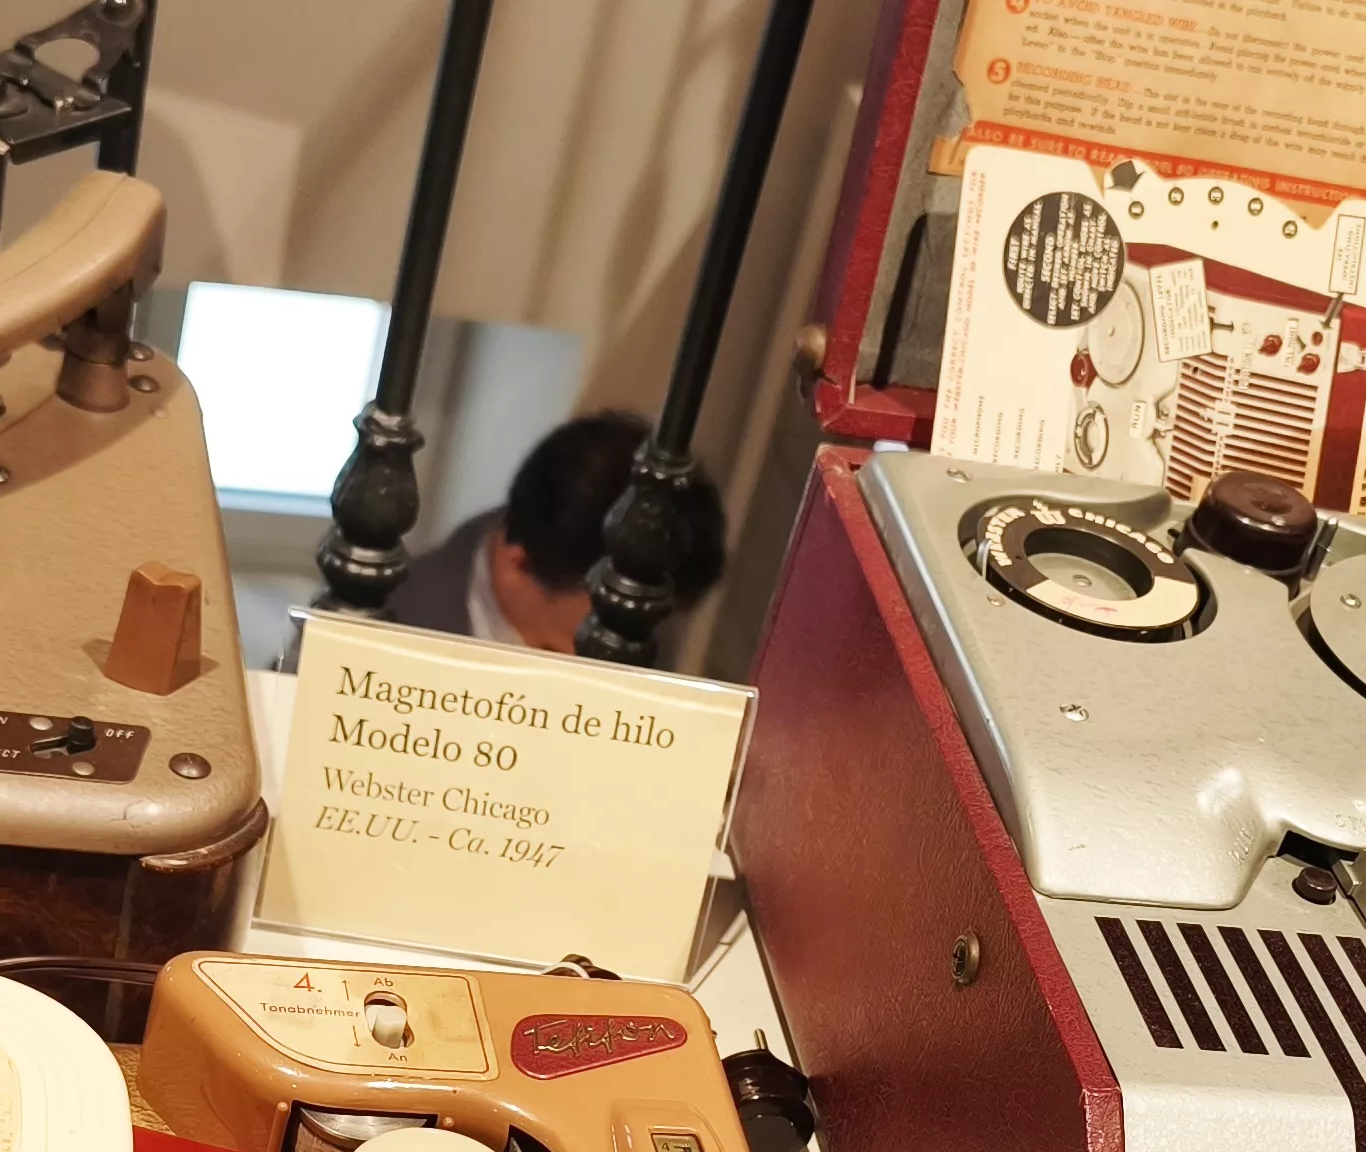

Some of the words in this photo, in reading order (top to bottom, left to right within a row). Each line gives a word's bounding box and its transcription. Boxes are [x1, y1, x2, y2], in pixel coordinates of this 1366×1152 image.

[1067, 508, 1175, 564] CHICAGO
[336, 666, 549, 731] Magnetofón
[562, 705, 601, 738] de
[611, 708, 675, 749] hilo
[105, 728, 135, 740] OFF
[329, 714, 462, 763] Modelo
[473, 742, 519, 772] 80
[323, 766, 435, 809] Webster
[442, 786, 551, 828] Chicago
[314, 807, 418, 843] EE.UU.
[448, 828, 489, 856] Ca.
[500, 837, 565, 869] 1947
[293, 972, 323, 992] 4.
[373, 977, 394, 987] Ab
[259, 1002, 361, 1018] Tonabnehmer
[523, 1018, 676, 1059] Tefifon
[388, 1052, 408, 1062] An
[661, 1142, 671, 1152] 4
